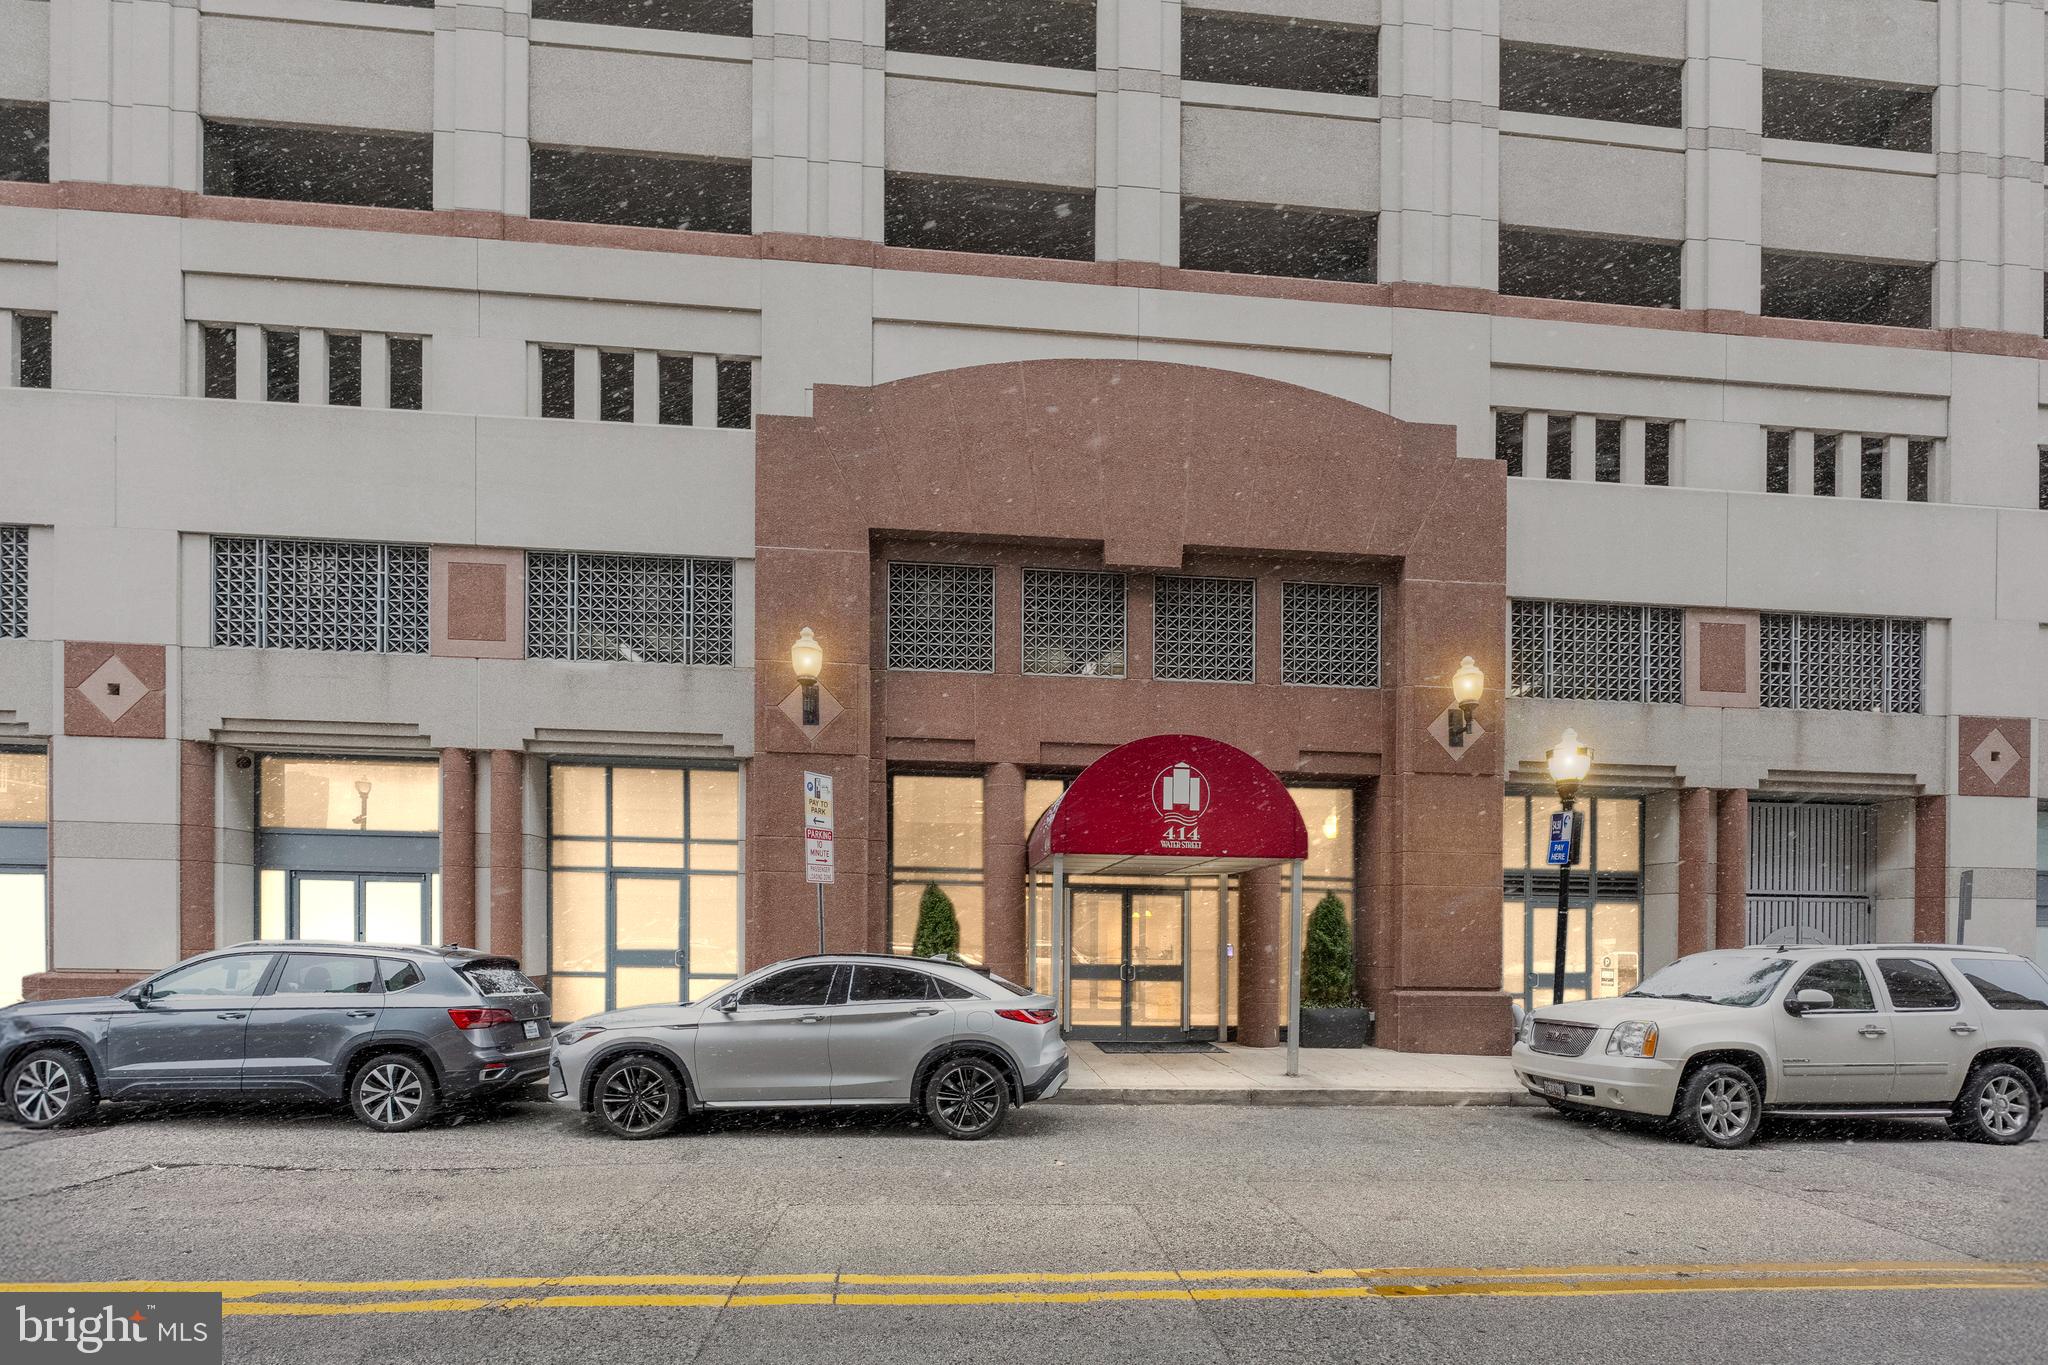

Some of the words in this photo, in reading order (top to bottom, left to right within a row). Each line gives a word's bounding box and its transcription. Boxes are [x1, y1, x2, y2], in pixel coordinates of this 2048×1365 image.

[809, 799, 819, 807] PAY
[820, 800, 828, 808] TO
[811, 806, 826, 815] PARK
[807, 829, 832, 840] PARKING
[1163, 826, 1200, 840] 414
[1161, 840, 1181, 848] WATER
[1181, 841, 1202, 849] STREET
[810, 849, 830, 857] MINUTE
